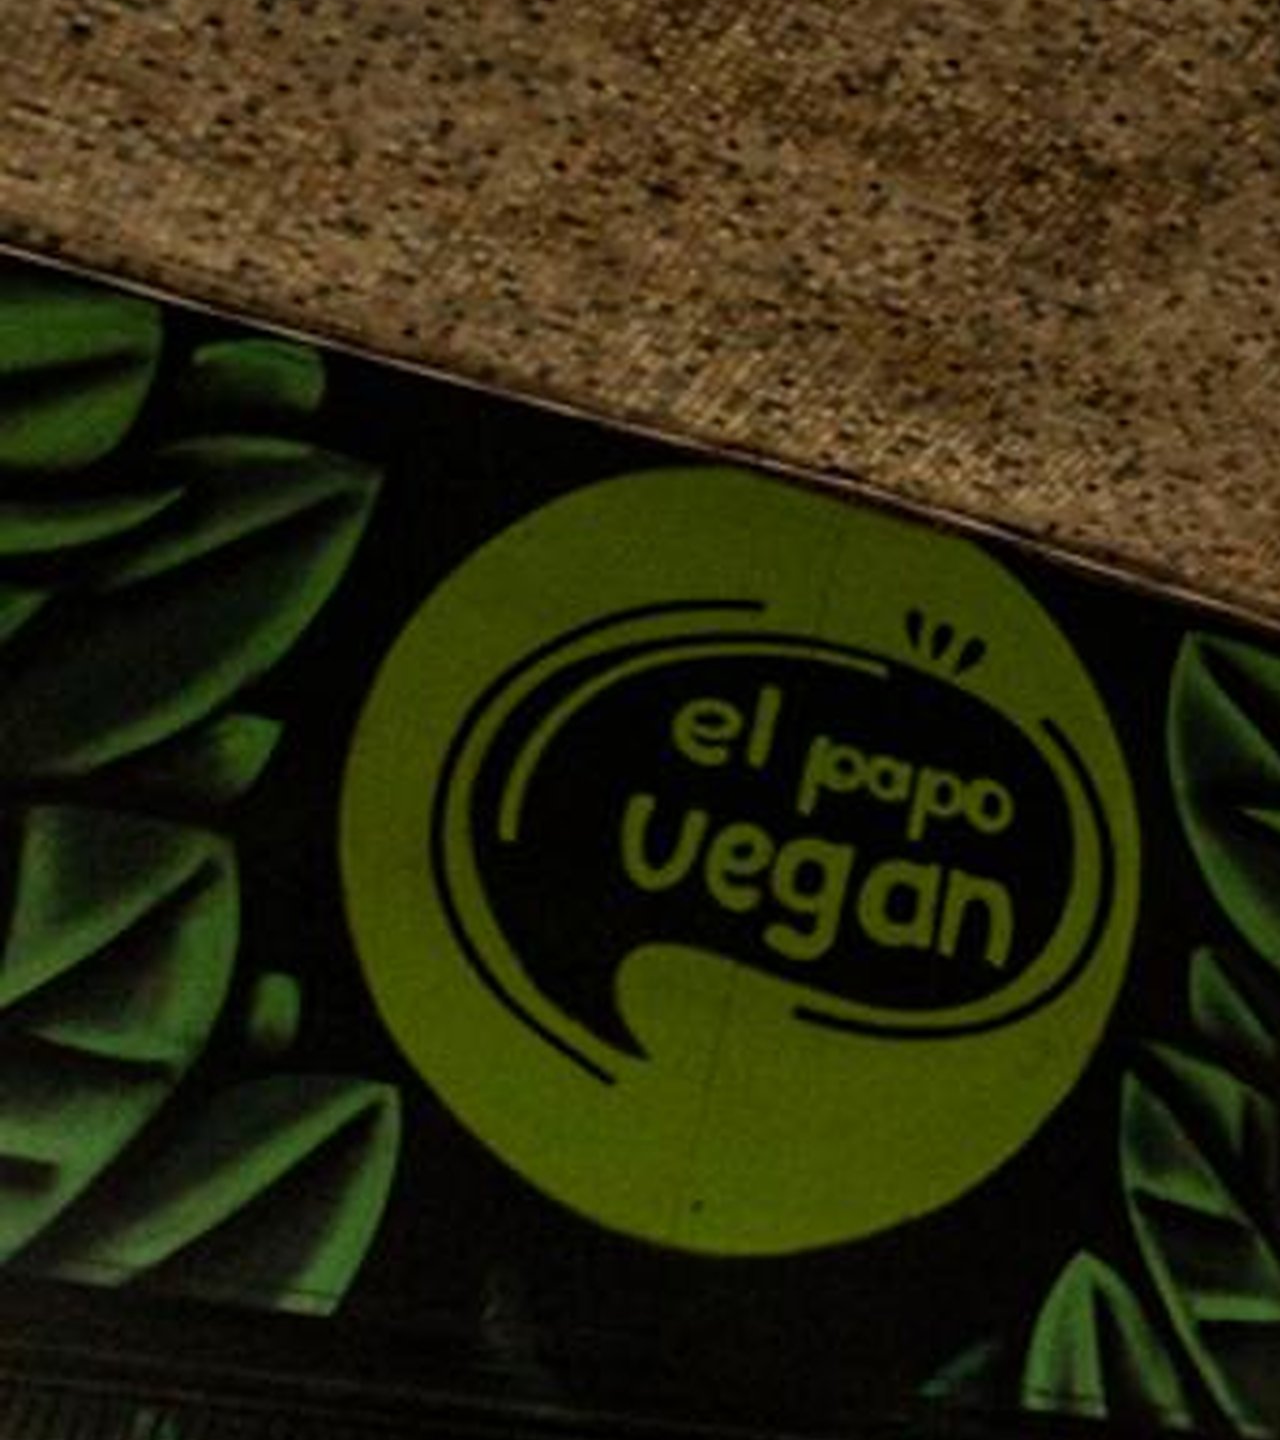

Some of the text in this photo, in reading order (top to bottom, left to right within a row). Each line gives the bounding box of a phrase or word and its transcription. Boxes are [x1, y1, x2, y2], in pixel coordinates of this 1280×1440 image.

[671, 684, 1015, 843] el papo
[620, 792, 1014, 968] vegan
